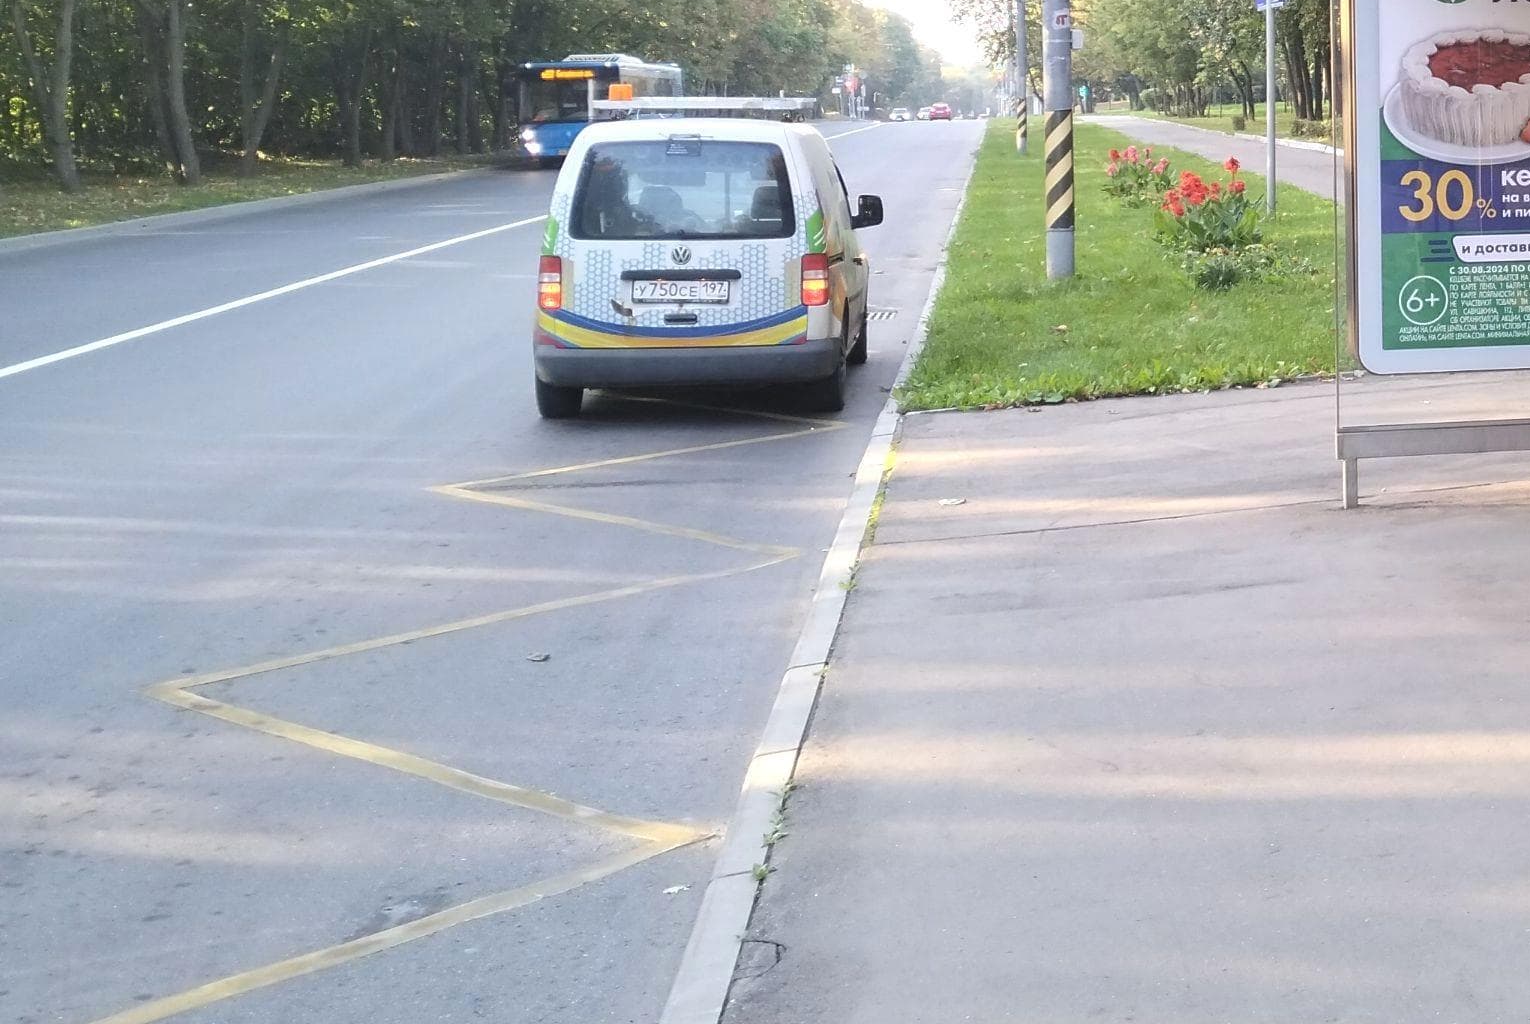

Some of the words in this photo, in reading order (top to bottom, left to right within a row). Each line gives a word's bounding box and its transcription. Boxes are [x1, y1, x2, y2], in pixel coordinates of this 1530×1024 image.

[1502, 194, 1520, 203] на
[1502, 209, 1511, 218] и
[1462, 245, 1471, 254] и
[1449, 266, 1455, 275] С
[1457, 264, 1508, 275] 30.08.2024
[1511, 264, 1525, 273] ПО
[1407, 288, 1440, 313] 6+
